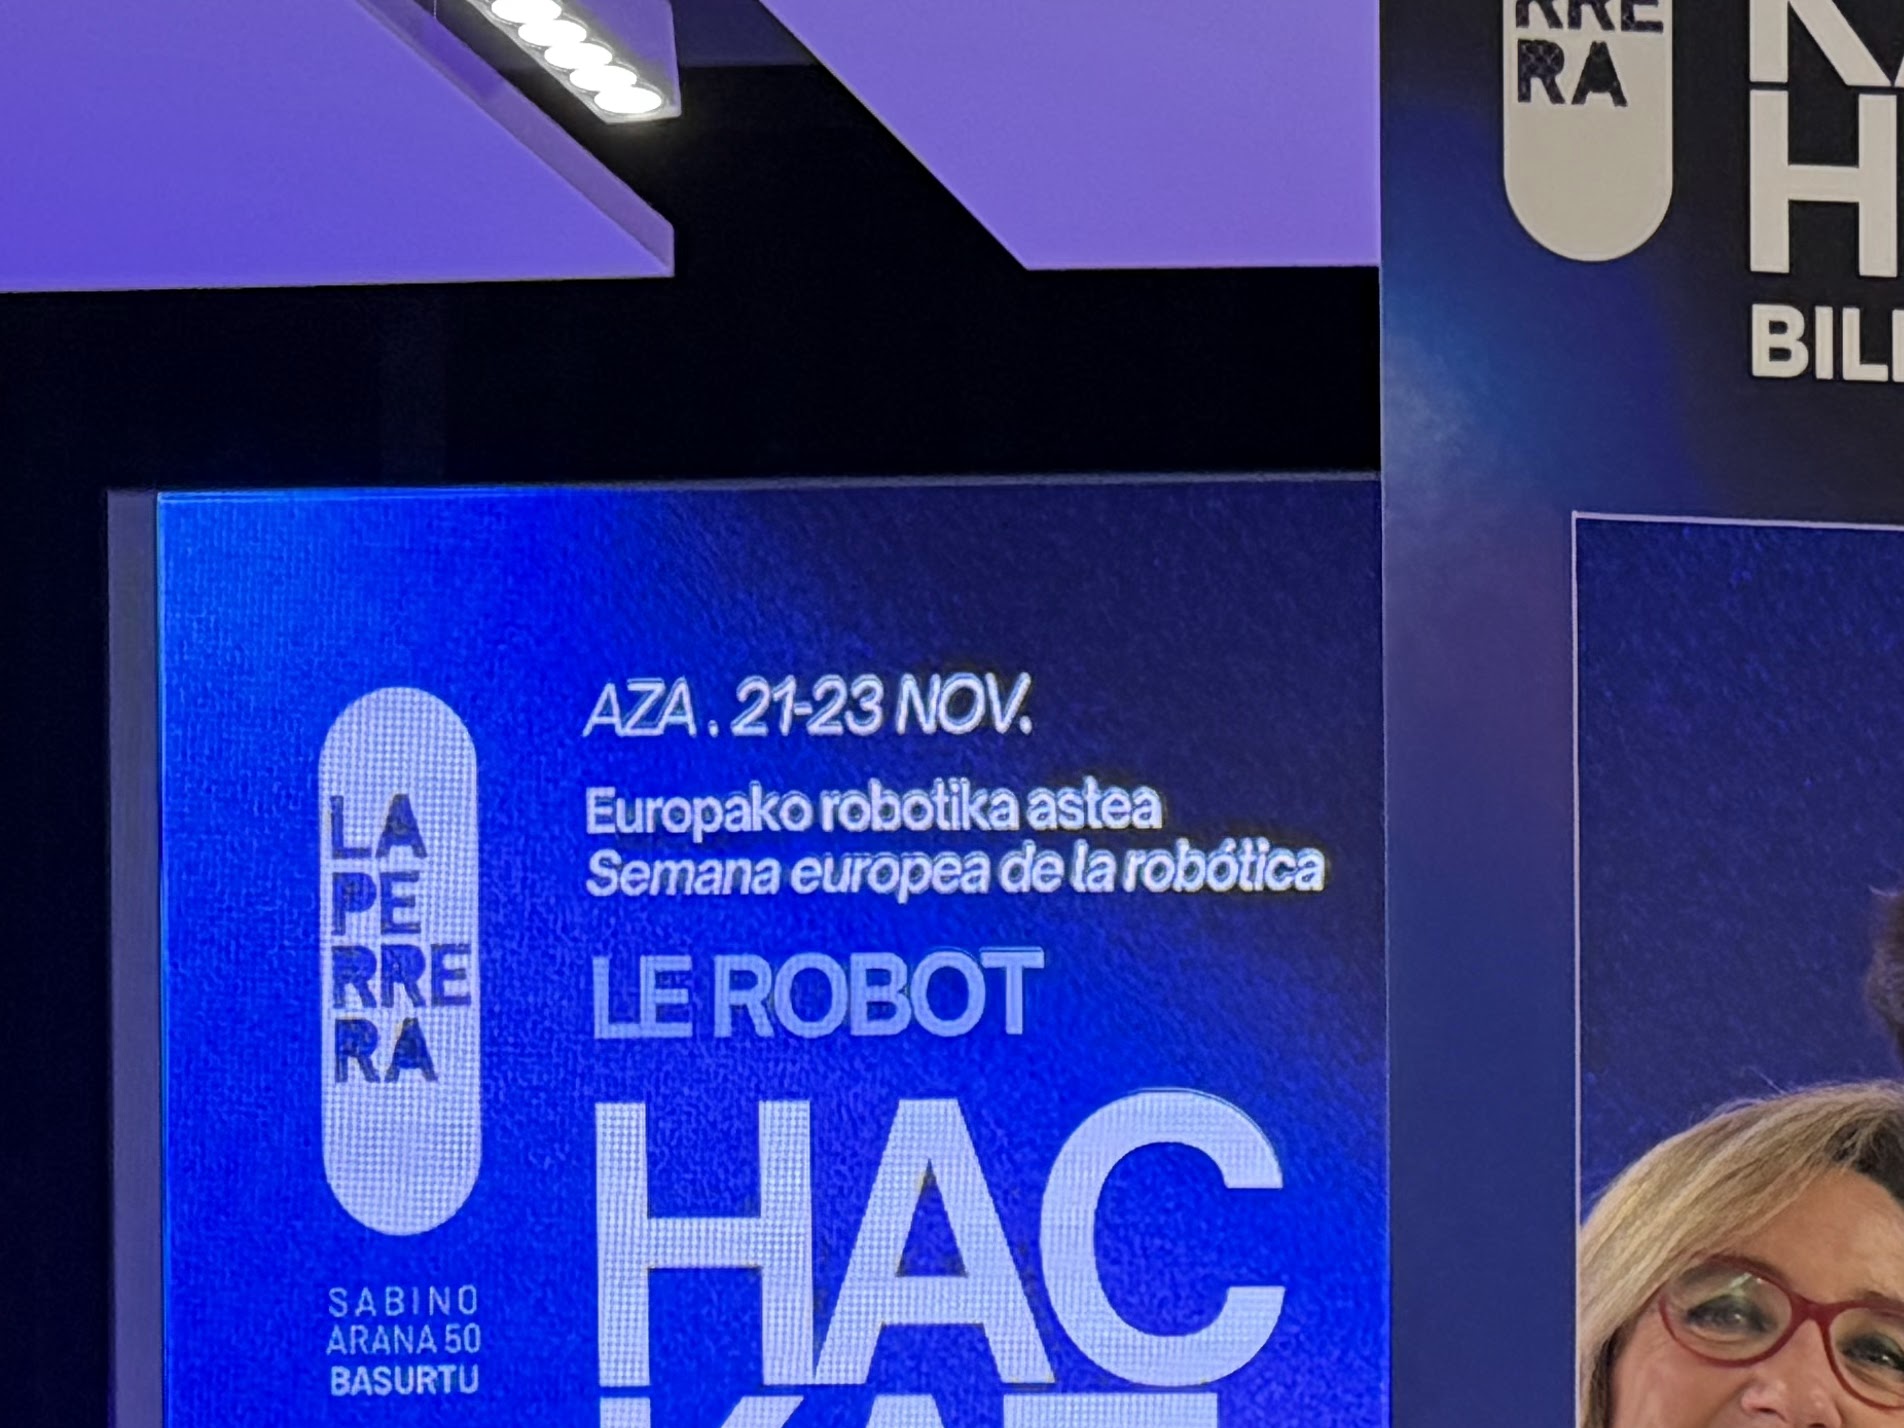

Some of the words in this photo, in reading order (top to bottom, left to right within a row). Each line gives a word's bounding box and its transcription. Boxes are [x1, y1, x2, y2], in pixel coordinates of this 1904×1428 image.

[1518, 38, 1628, 107] RA
[731, 673, 885, 736] 21-23
[896, 672, 1032, 735] NOV.
[329, 793, 428, 860] LA
[586, 784, 814, 843] Europako
[820, 777, 1020, 832] robotika
[1026, 776, 1163, 830] astea
[331, 870, 421, 936] PE
[586, 848, 782, 897] Semana
[790, 850, 991, 904] europea
[1000, 839, 1064, 893] de
[1070, 840, 1116, 892] la
[1122, 837, 1326, 892] robótica
[331, 942, 472, 1009] RRE
[592, 954, 693, 1039] LE
[713, 946, 1045, 1039] ROBOT
[333, 1017, 438, 1083] RA
[595, 1088, 1285, 1388] HAC
[328, 1284, 478, 1317] SABINO
[326, 1323, 435, 1355] ARANA
[444, 1322, 482, 1354] 50
[330, 1364, 479, 1397] BASURTU
